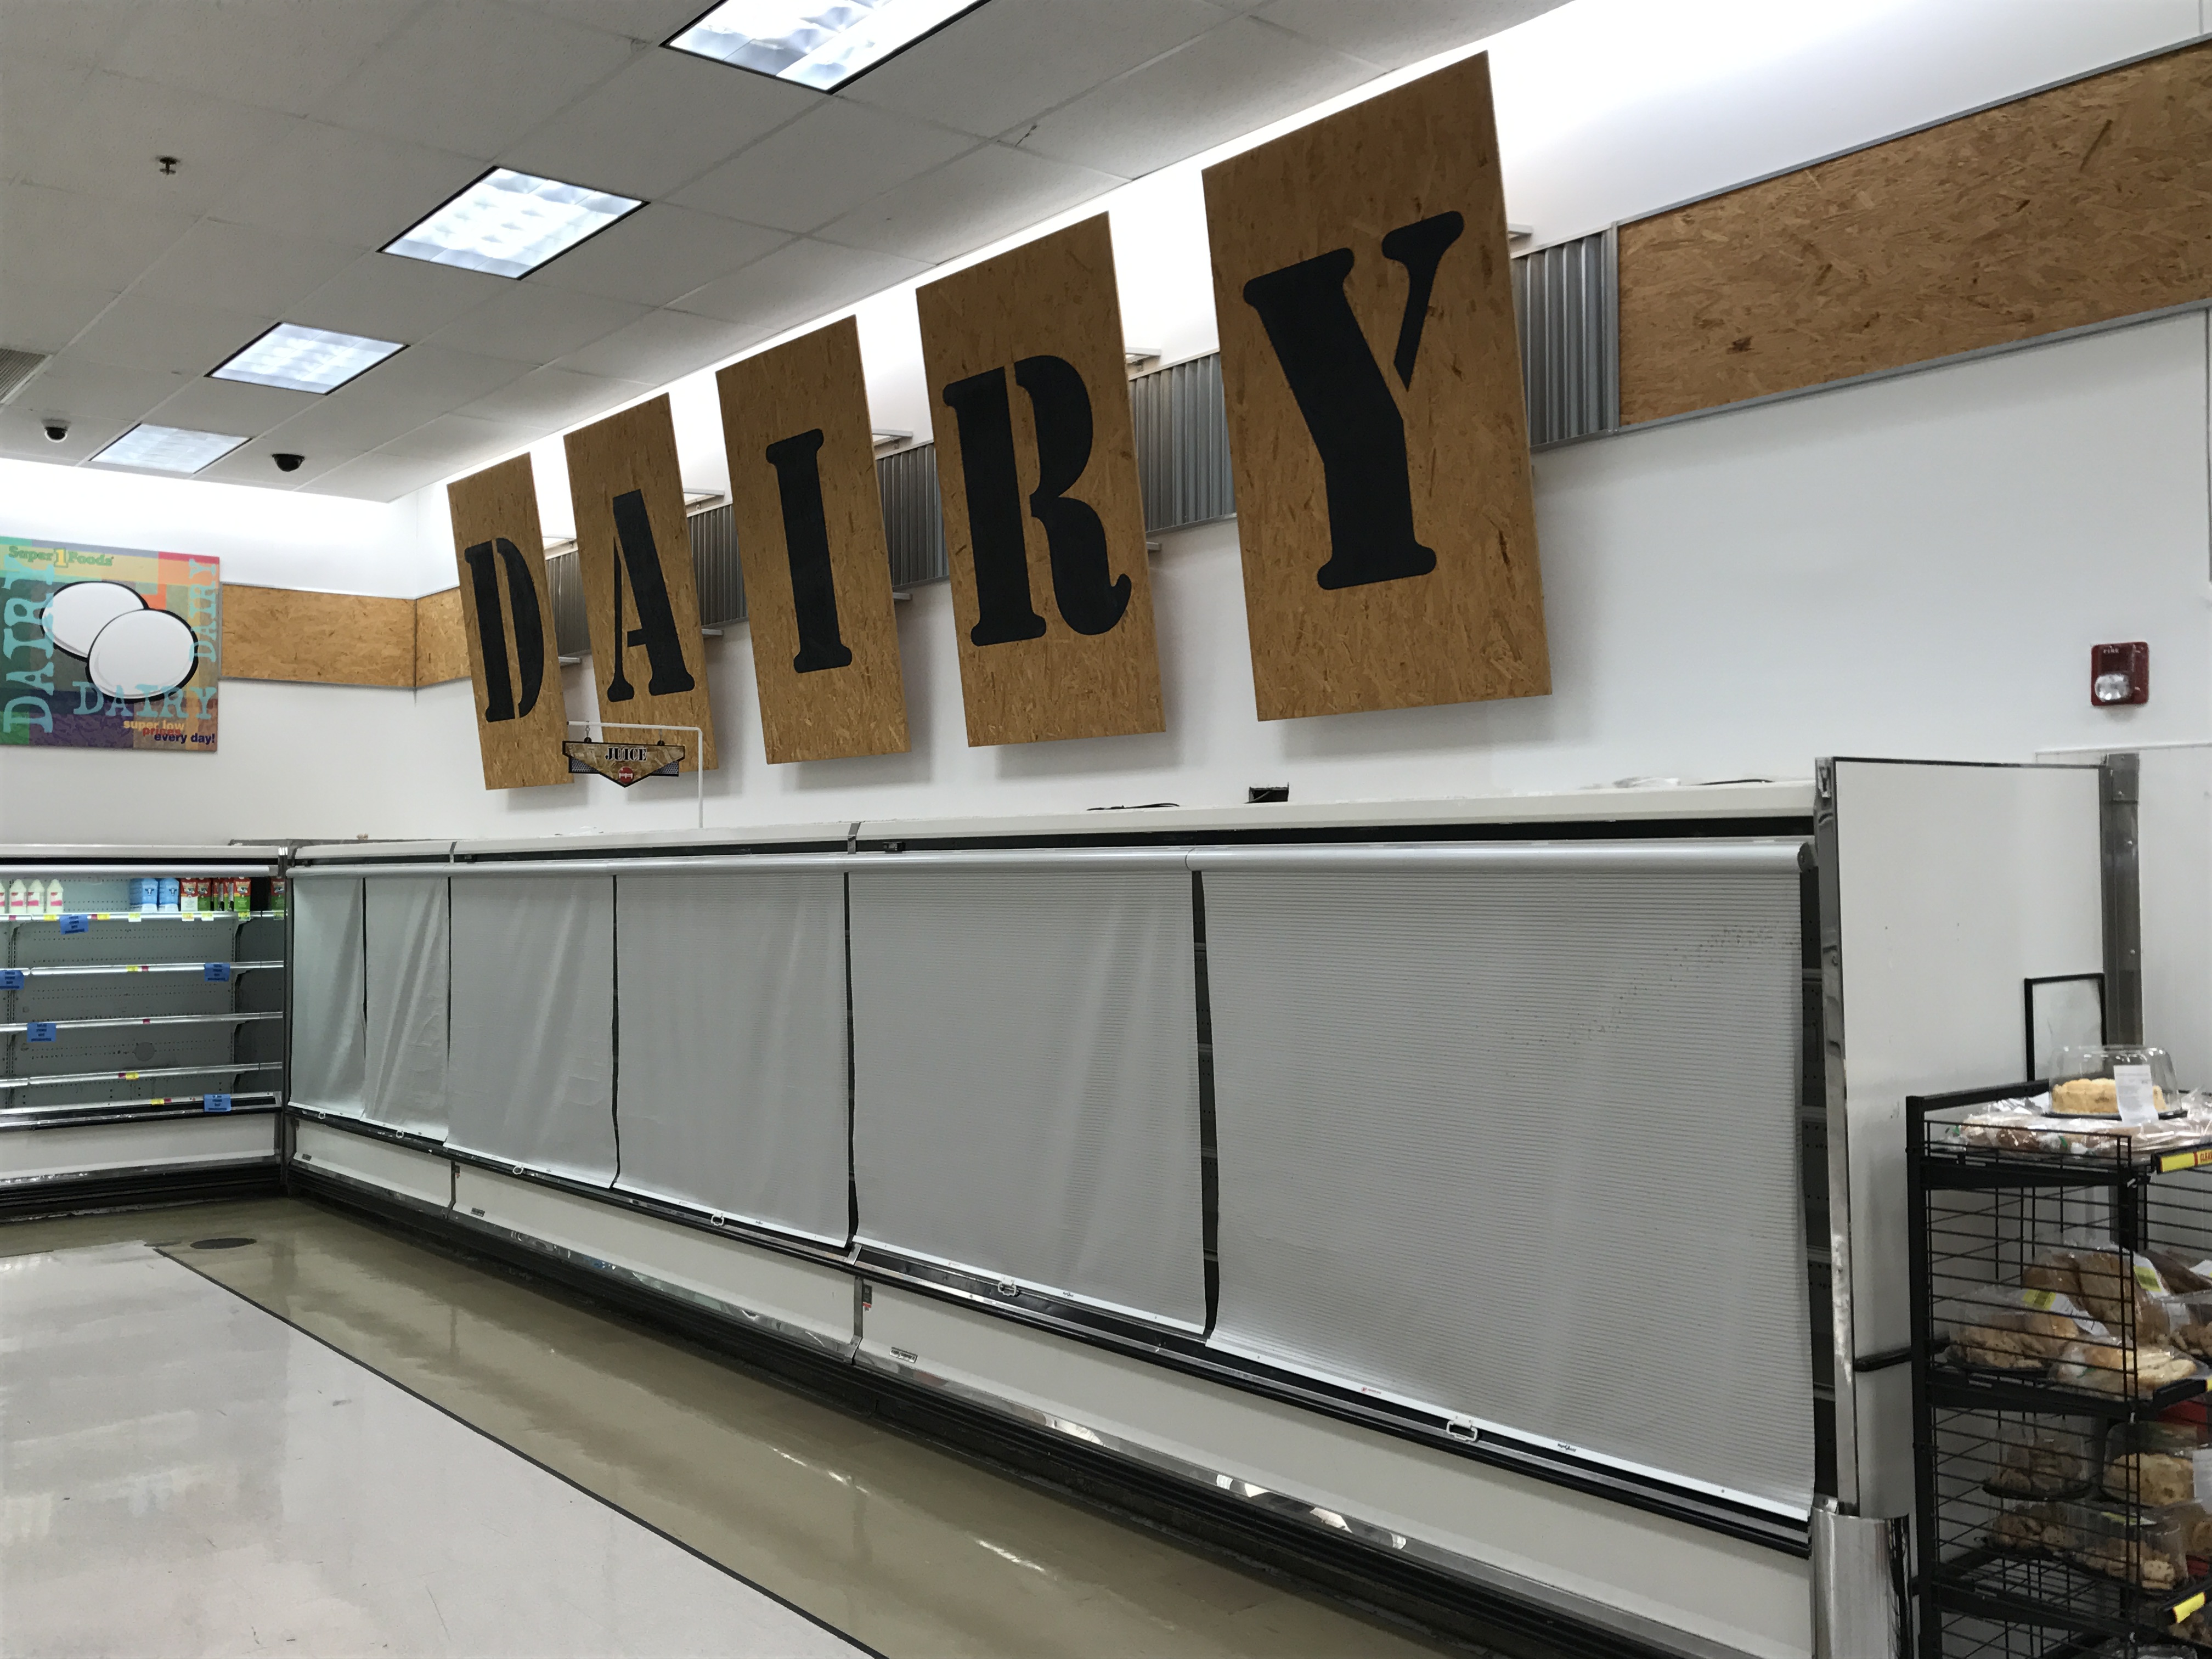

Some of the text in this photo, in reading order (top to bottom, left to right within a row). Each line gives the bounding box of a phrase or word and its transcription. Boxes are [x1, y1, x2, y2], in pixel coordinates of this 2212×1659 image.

[465, 211, 1464, 723] DAIRY
[9, 546, 112, 568] Super 1 Foods
[189, 558, 217, 662] DAIRY
[1, 554, 54, 733] DAIRY
[72, 681, 217, 720] DAIRY
[123, 720, 184, 732] super low
[143, 727, 181, 736] prices
[154, 733, 215, 745] every day!
[605, 747, 647, 761] JUICE
